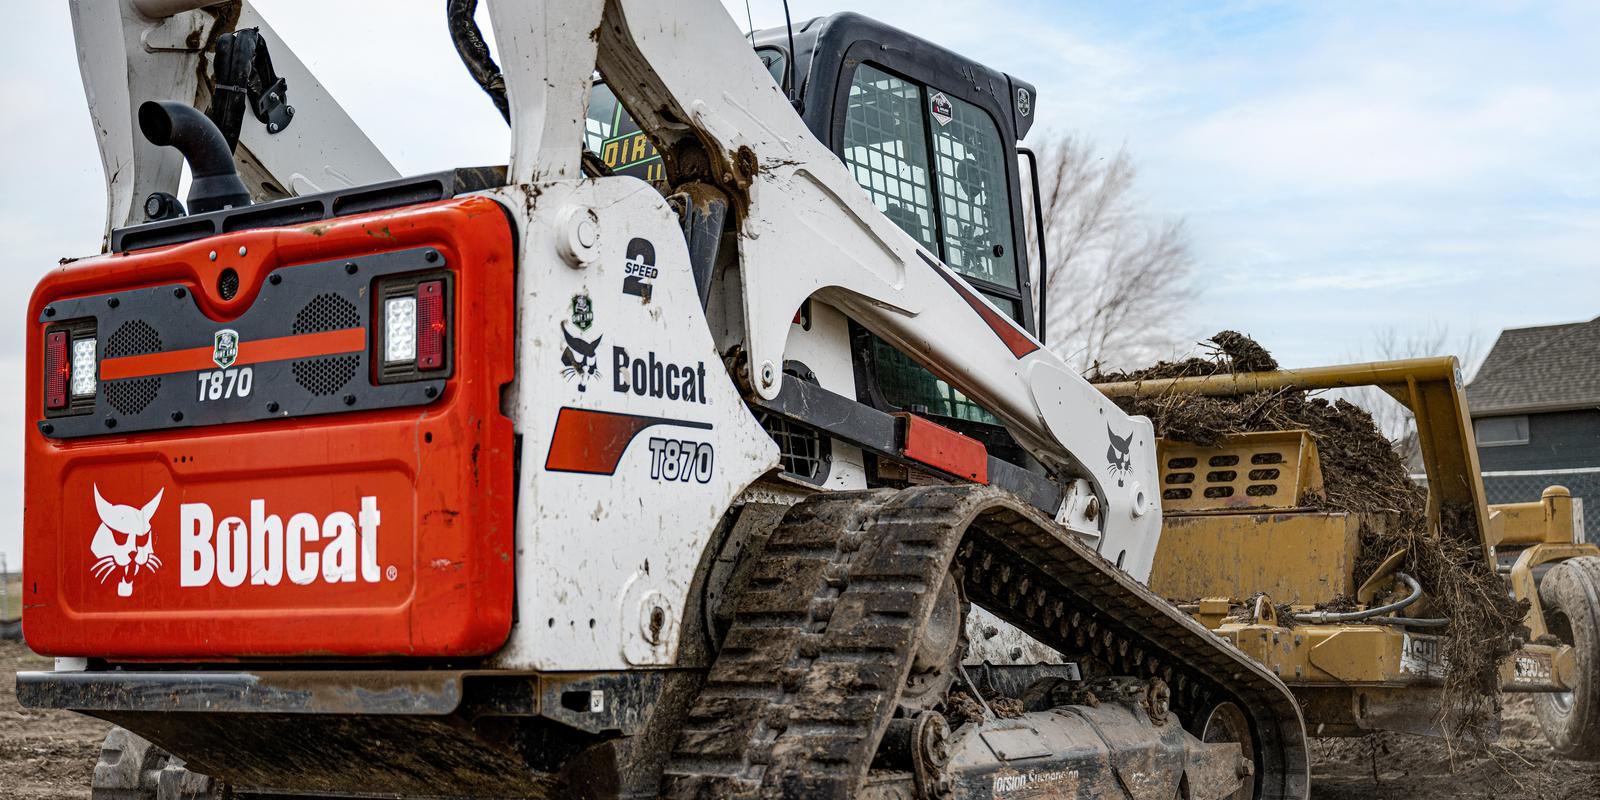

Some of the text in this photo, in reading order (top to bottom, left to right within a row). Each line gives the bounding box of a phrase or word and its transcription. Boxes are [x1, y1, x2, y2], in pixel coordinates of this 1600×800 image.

[604, 134, 658, 167] DIR
[622, 237, 658, 304] 2 SPEED
[198, 367, 253, 402] T870
[613, 345, 706, 405] Bobcat
[648, 436, 714, 484] T870
[180, 496, 381, 588] Bobcat
